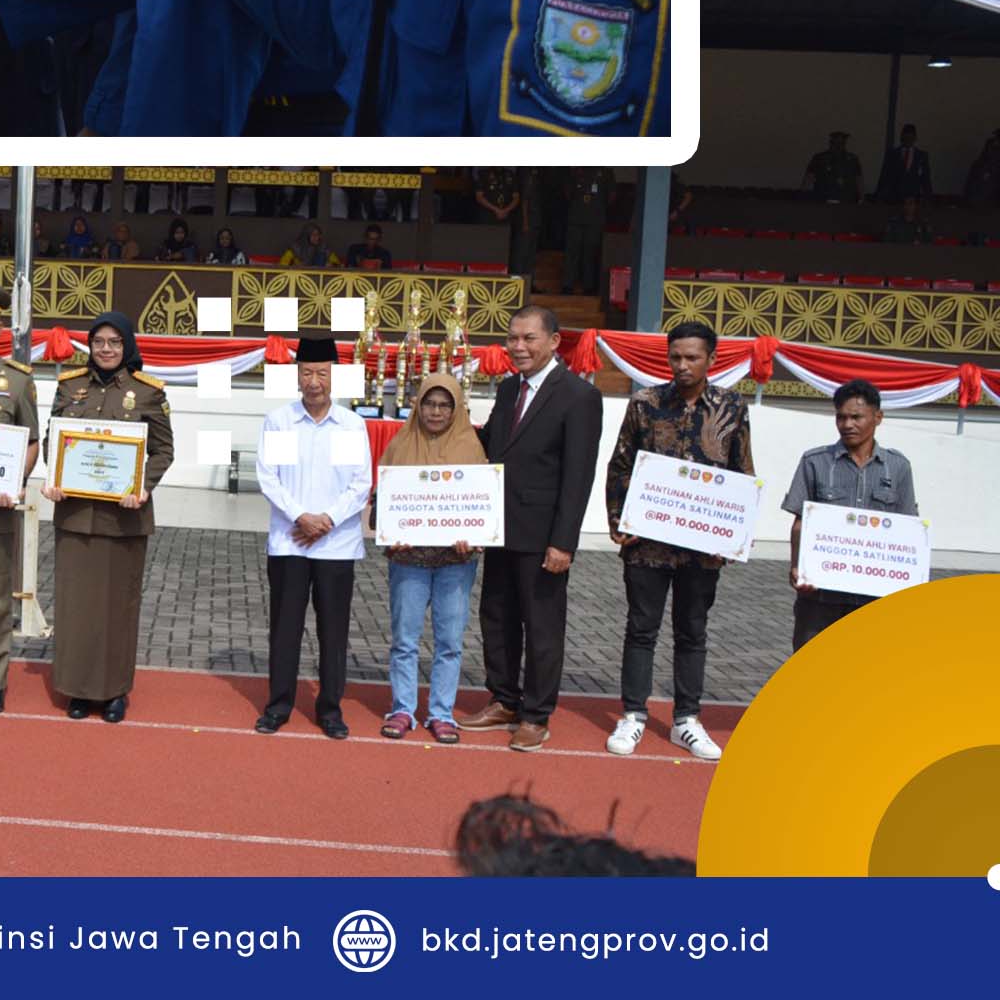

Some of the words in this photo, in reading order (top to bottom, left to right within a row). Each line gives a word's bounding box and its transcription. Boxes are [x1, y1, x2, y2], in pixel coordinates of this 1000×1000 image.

[388, 503, 435, 512] ANGGOTA
[437, 503, 492, 512] SATLINMAS
[390, 493, 438, 501] SANTUNAN
[439, 493, 460, 501] AHLI
[461, 493, 490, 501] WARIS
[644, 482, 693, 500] SANTUNAN
[693, 493, 715, 505] AHLI
[715, 500, 745, 513] WARIS
[639, 493, 687, 511] ANGGOTA
[688, 504, 745, 525] SATLINMAS
[427, 518, 485, 527] 10.000.000
[674, 516, 734, 539] 10.000.000
[812, 543, 861, 557] ANGGOTA
[862, 550, 918, 566] SATLINMAS
[815, 533, 865, 547] SANTUNAN
[865, 539, 887, 549] AHLI
[887, 543, 917, 555] WARIS
[851, 564, 910, 581] 10.000.000
